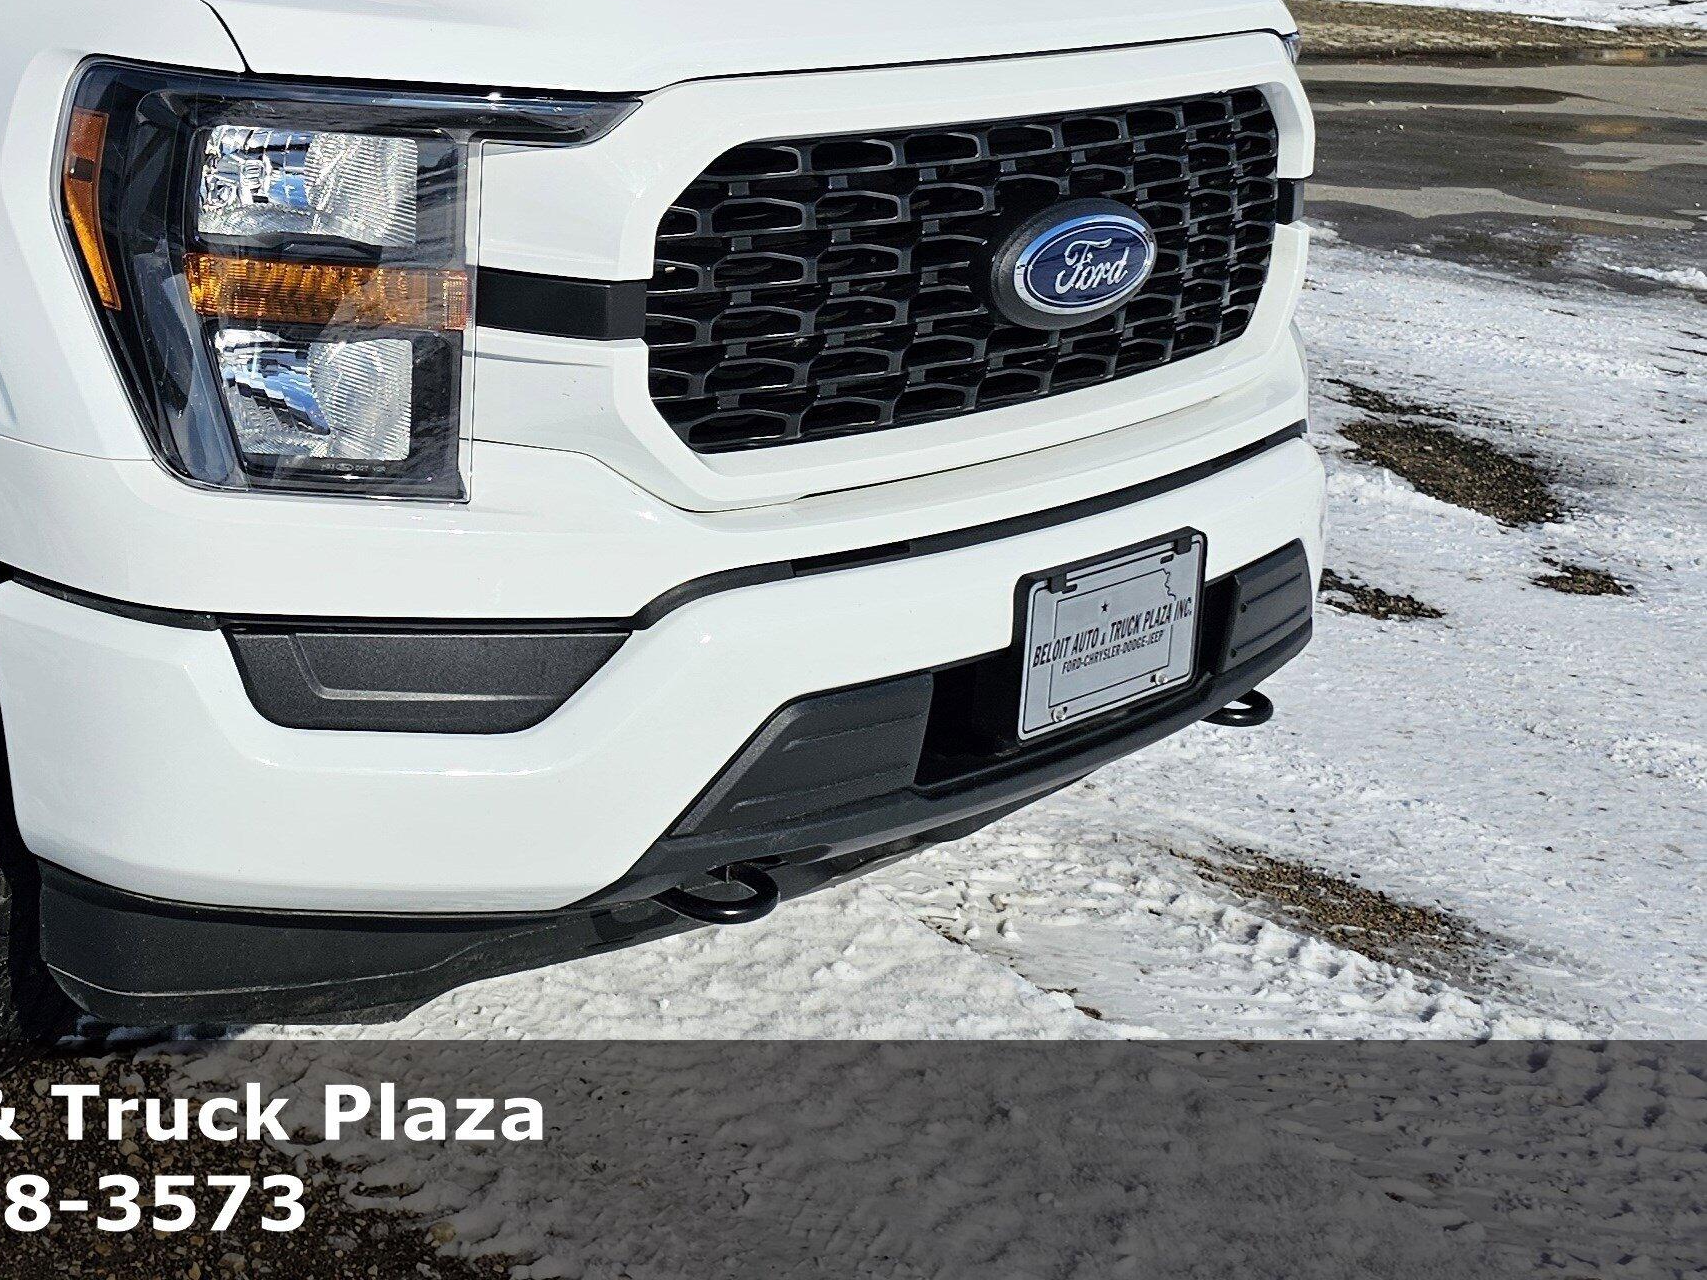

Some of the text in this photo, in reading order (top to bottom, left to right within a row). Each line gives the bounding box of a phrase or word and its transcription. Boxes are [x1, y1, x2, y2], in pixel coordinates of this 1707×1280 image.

[1055, 237, 1130, 295] Ford
[1032, 635, 1072, 668] BELOIT
[1071, 627, 1099, 656] AUTO
[1109, 612, 1143, 644] TRUCK
[1142, 602, 1172, 632] PLAZA
